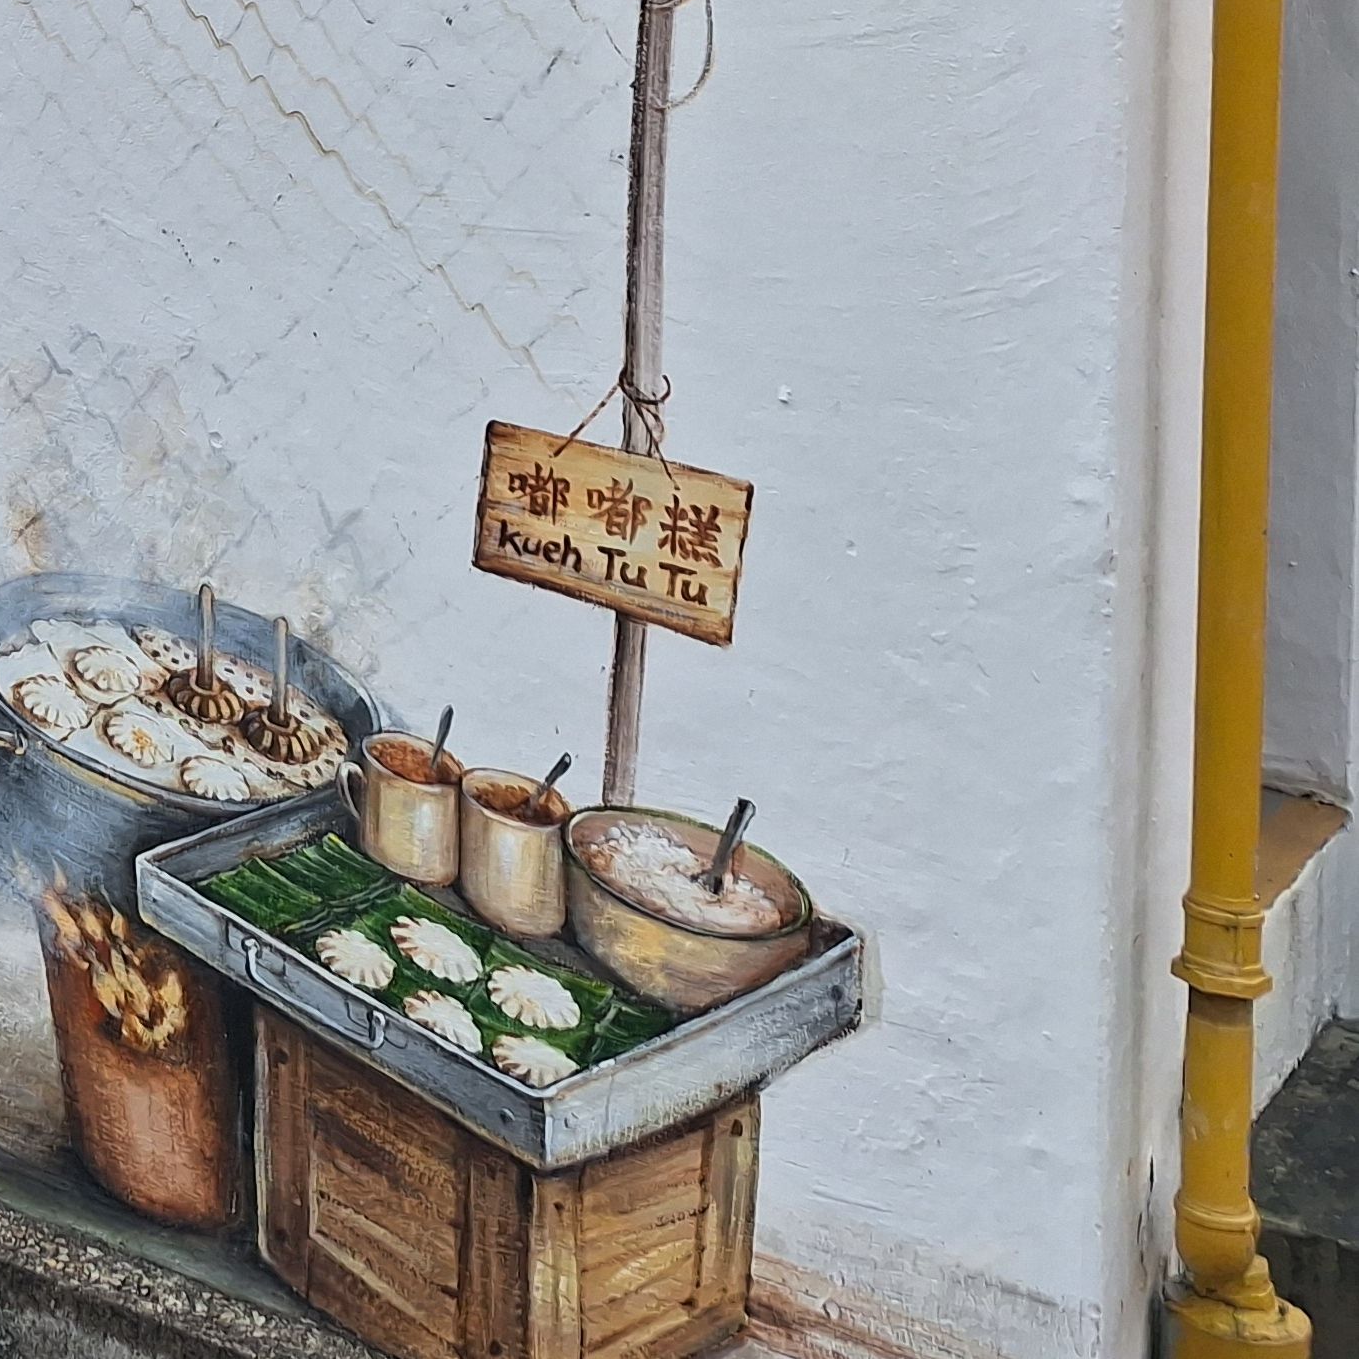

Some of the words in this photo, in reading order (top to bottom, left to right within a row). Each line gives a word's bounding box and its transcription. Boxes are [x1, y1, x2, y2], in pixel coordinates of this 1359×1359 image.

[508, 462, 724, 568] 嘟嘟糕
[597, 544, 648, 591] Tu
[658, 560, 709, 607] Tu
